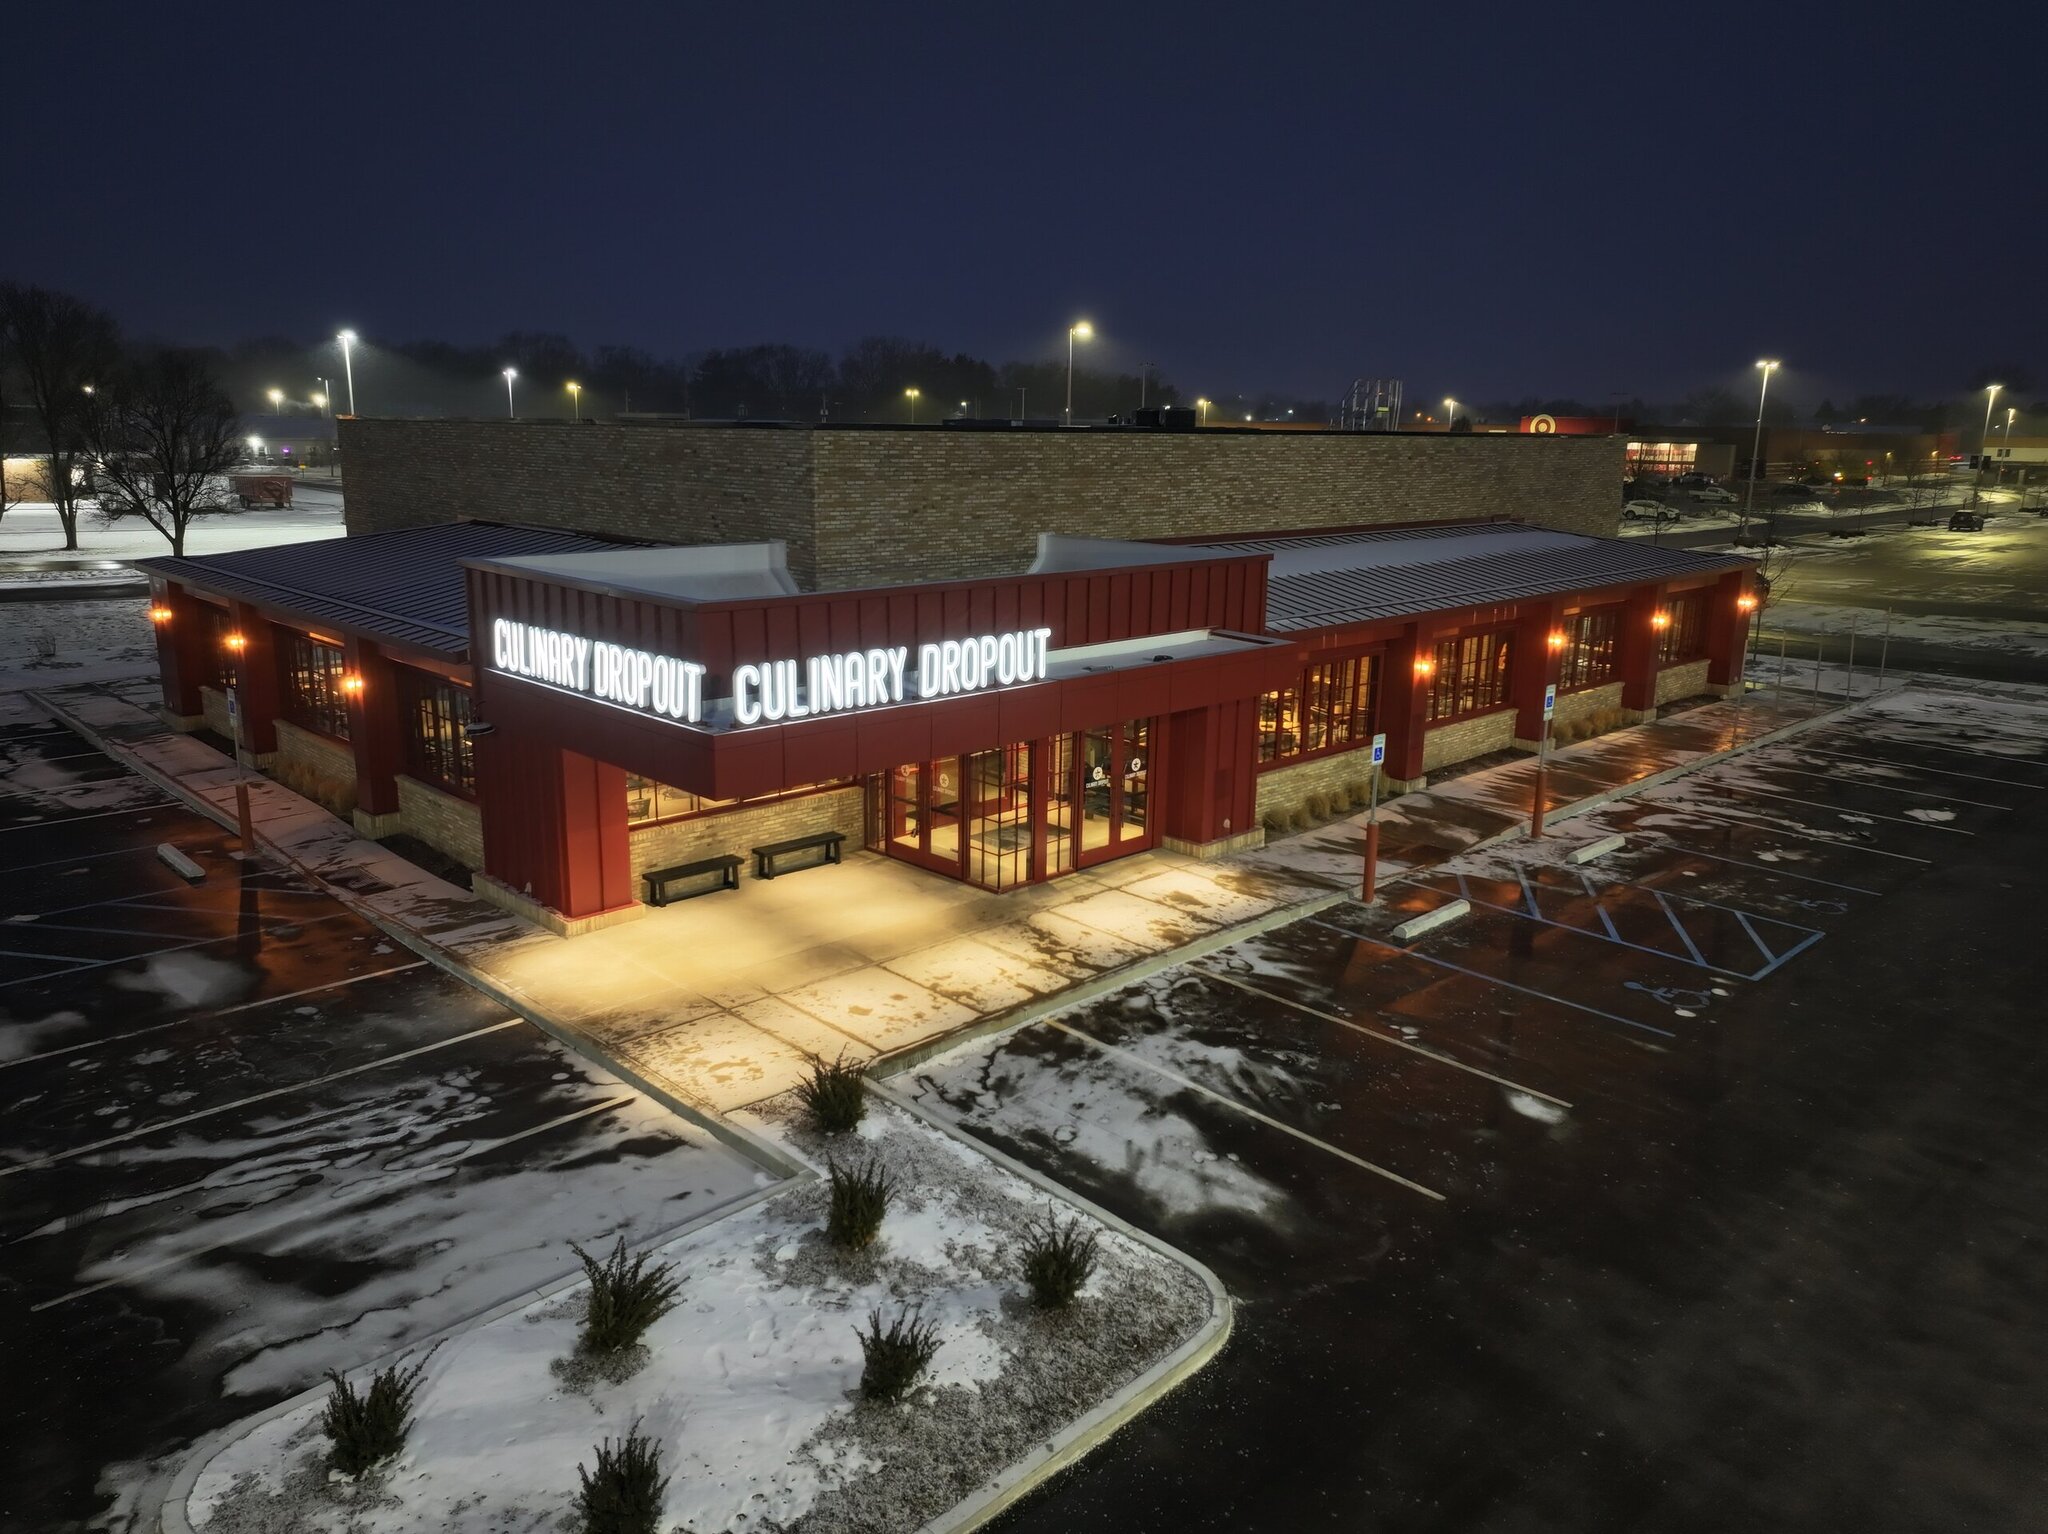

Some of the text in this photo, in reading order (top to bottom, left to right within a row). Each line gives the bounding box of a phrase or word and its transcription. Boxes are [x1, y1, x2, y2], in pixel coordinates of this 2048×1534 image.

[494, 617, 707, 723] CULINARY DROPOUT
[732, 627, 1052, 725] CULINARY DROPOUT
